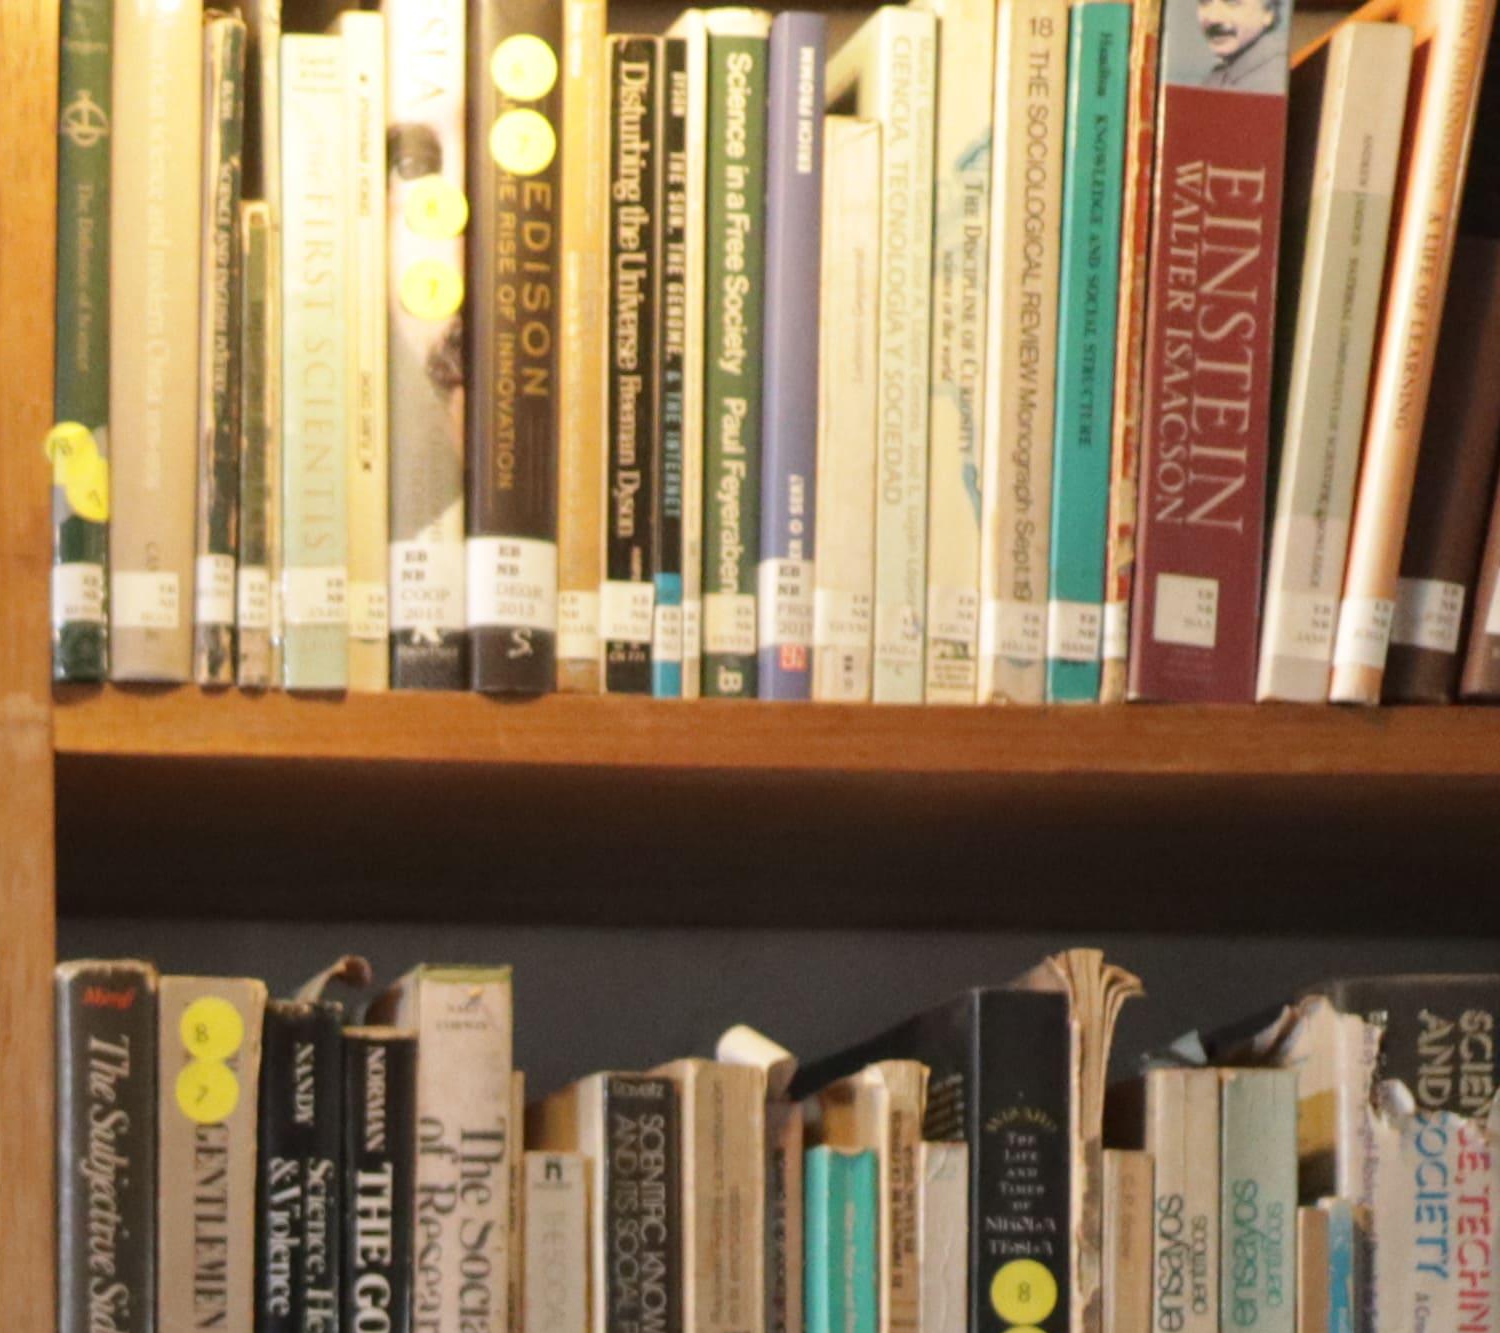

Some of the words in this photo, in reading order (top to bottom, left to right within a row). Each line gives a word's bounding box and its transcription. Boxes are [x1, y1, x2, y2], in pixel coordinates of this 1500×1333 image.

[722, 53, 751, 159] Science
[1027, 51, 1048, 98] THE
[616, 61, 647, 200] Disturbing
[724, 166, 750, 188] in
[618, 206, 645, 248] the
[722, 212, 750, 271] Free
[725, 192, 746, 210] a
[1022, 104, 1049, 286] SOCIOLOGICAL
[1165, 160, 1204, 312] WALTER
[522, 179, 551, 397] EDISON
[616, 252, 647, 369] Universe
[719, 274, 750, 376] Society
[1018, 292, 1042, 384] REVIEW
[1186, 164, 1265, 535] EINSTEIN
[1012, 388, 1037, 513] Monograph
[1155, 328, 1196, 524] ISAACSON
[88, 1034, 128, 1100] The
[79, 1104, 131, 1274] Subjective
[193, 1122, 230, 1329] GENTLEMEN
[355, 1162, 391, 1267] THE
